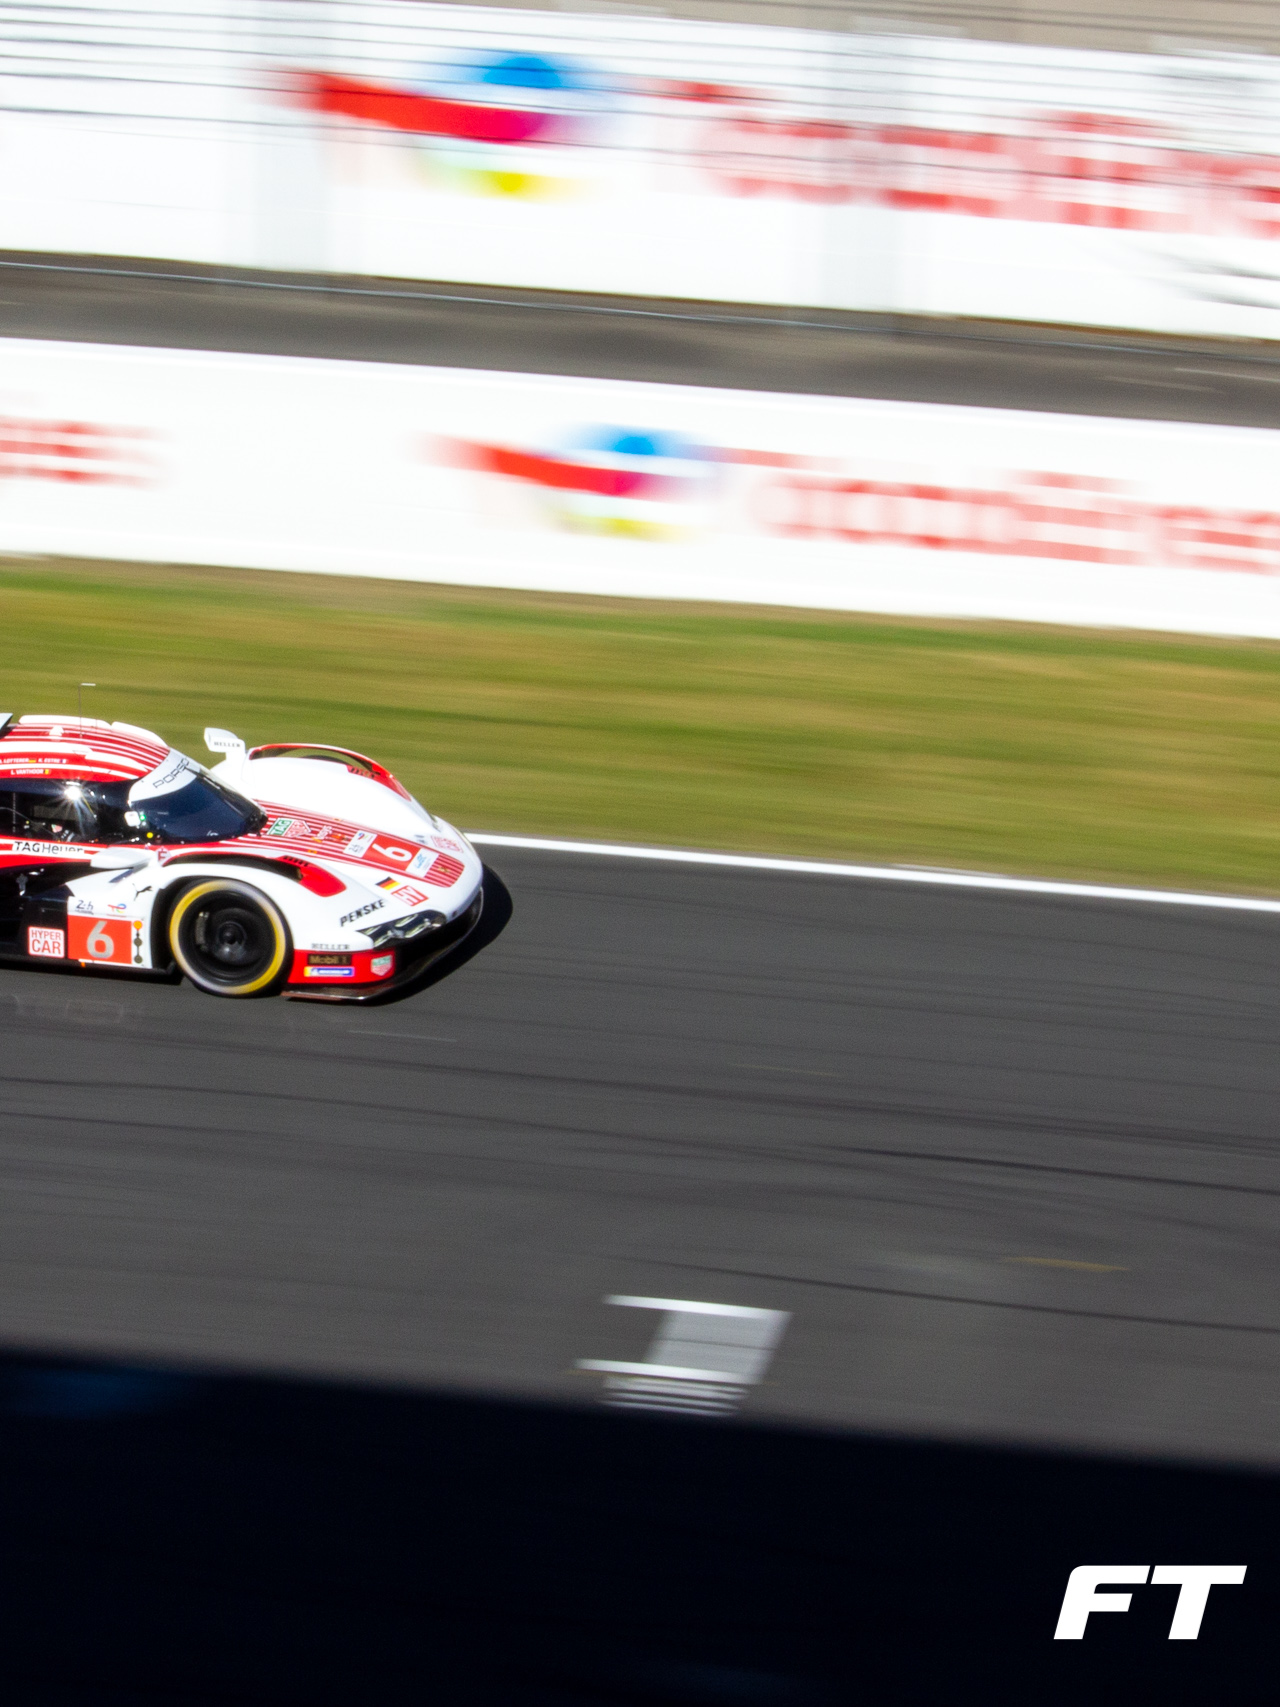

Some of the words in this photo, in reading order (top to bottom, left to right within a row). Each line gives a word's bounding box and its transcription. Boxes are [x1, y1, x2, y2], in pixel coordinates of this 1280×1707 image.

[371, 843, 413, 862] 6
[392, 885, 428, 906] HY
[339, 899, 386, 927] PENSKE
[31, 929, 62, 941] HYPER
[86, 920, 115, 959] 6
[31, 940, 62, 955] CAR
